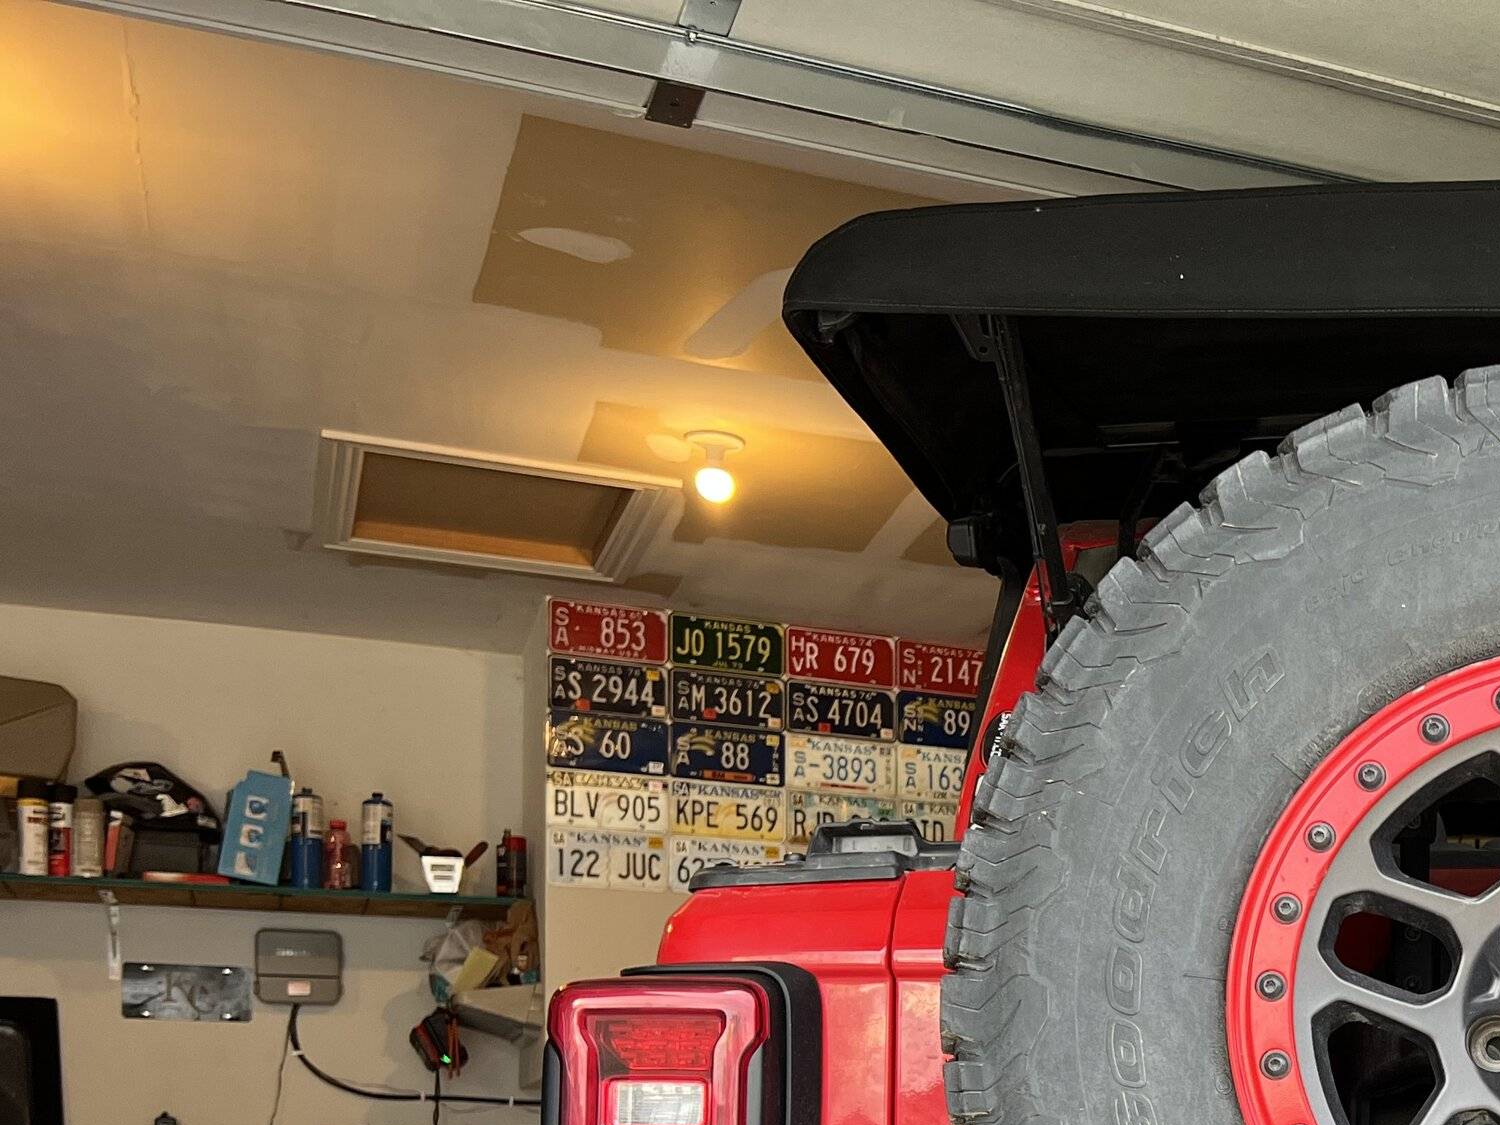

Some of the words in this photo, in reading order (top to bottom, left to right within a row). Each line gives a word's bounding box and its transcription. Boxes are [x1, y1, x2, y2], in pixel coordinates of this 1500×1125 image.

[600, 616, 646, 651] 853
[704, 620, 752, 634] KANSAS
[812, 633, 857, 647] KANSAS
[716, 631, 771, 664] 1579
[834, 646, 875, 676] 679
[931, 656, 984, 687] 2147
[592, 673, 655, 708] 2944
[714, 686, 772, 719] 3612
[809, 685, 857, 699] KANSAS
[929, 697, 976, 711] KANSAS
[828, 698, 882, 730] 4704
[944, 709, 970, 737] 89
[599, 729, 631, 760] 60
[705, 728, 756, 743] KANSAS
[811, 740, 873, 756] KANSAS
[721, 741, 749, 770] 88
[555, 789, 599, 818] BLV
[617, 794, 660, 822] 905
[698, 785, 760, 799] KANSAS
[676, 799, 719, 828] KPE
[736, 804, 778, 832] 569
[577, 833, 642, 846] KANSAS
[698, 842, 760, 856] KANSAS
[558, 848, 600, 878] 122
[618, 852, 661, 881] JUC
